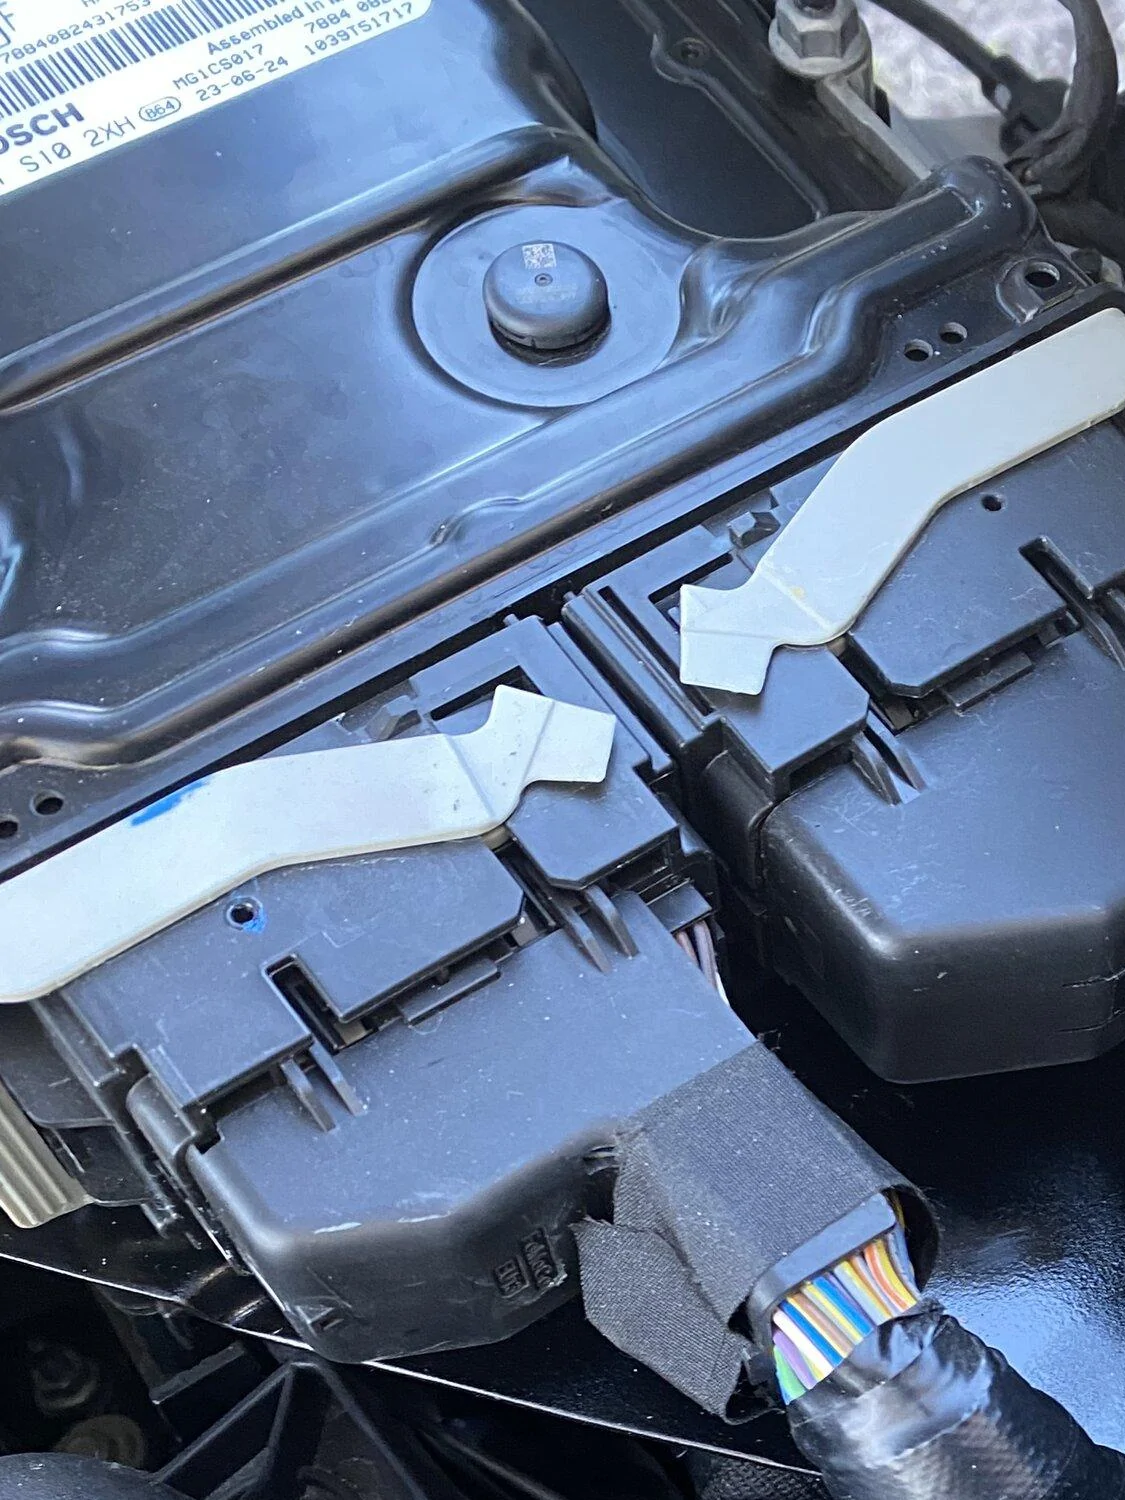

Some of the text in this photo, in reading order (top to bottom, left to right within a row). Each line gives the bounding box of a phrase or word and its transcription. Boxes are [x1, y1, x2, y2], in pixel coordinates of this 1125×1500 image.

[206, 6, 305, 55] Assembled
[304, 8, 351, 34] 7884
[196, 55, 289, 102] 23-06-24
[83, 116, 136, 148] 2XH
